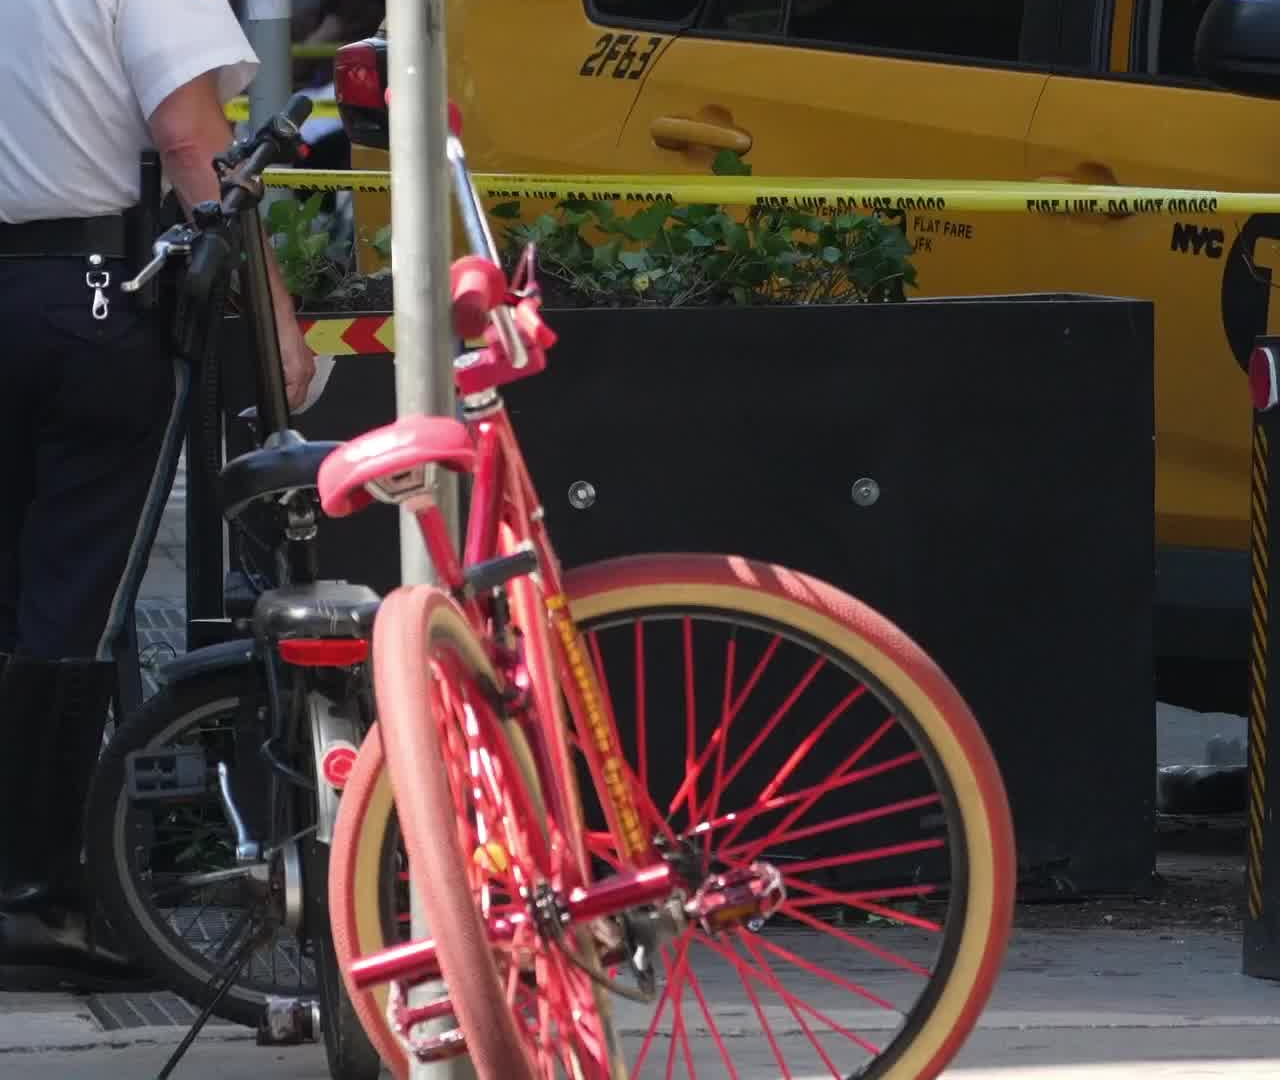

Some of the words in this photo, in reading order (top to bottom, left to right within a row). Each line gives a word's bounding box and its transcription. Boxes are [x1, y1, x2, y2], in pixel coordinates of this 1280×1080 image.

[580, 33, 662, 80] 2F63
[913, 215, 941, 232] FLAT
[944, 221, 973, 239] FARE
[1171, 222, 1225, 258] NYC
